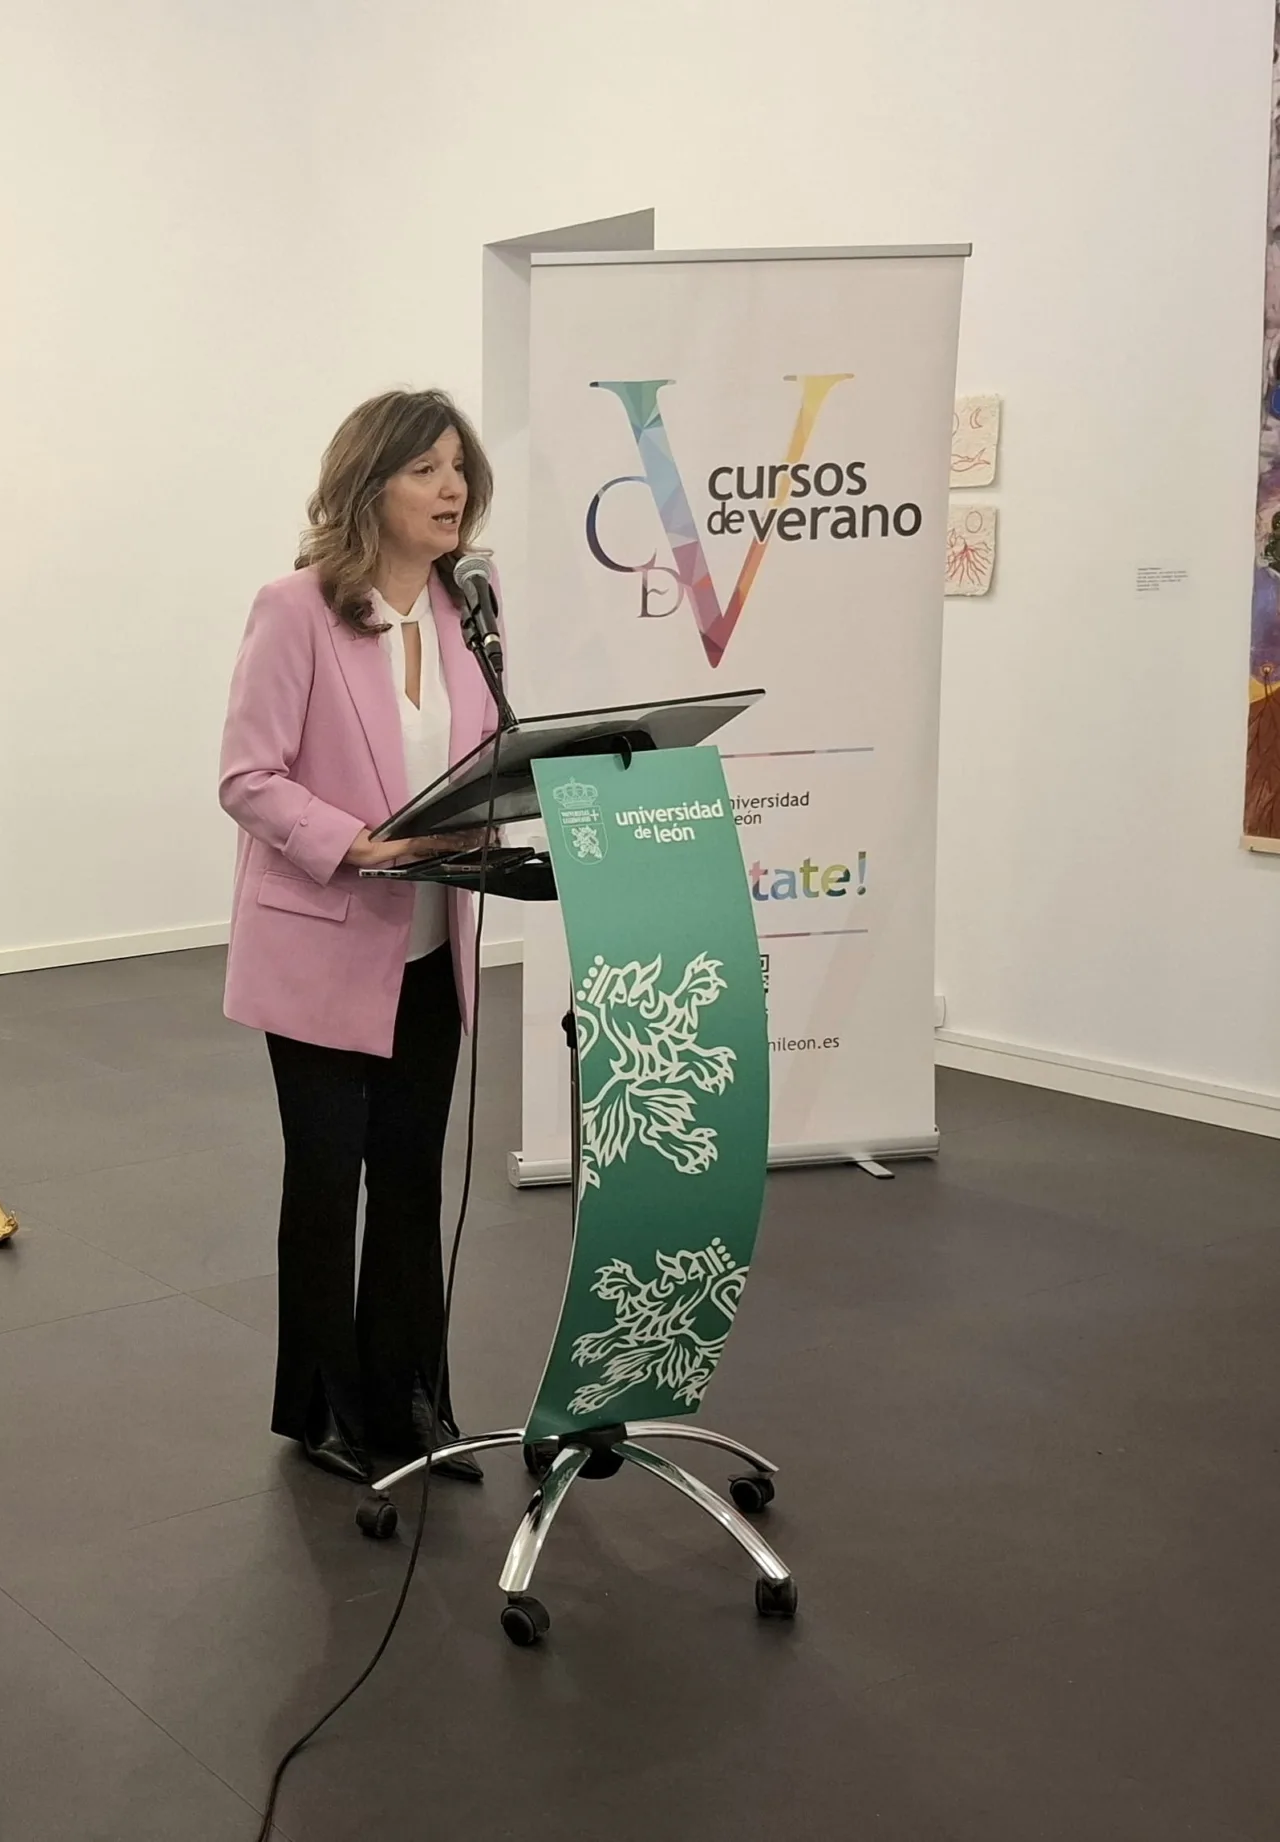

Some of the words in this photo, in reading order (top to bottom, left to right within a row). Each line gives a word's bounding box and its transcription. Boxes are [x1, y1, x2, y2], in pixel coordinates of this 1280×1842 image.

[708, 462, 867, 501] cursos
[707, 502, 745, 535] de
[748, 502, 921, 542] verano
[615, 799, 724, 825] universidad
[634, 825, 652, 839] de
[653, 823, 695, 843] león
[749, 851, 867, 901] tate!
